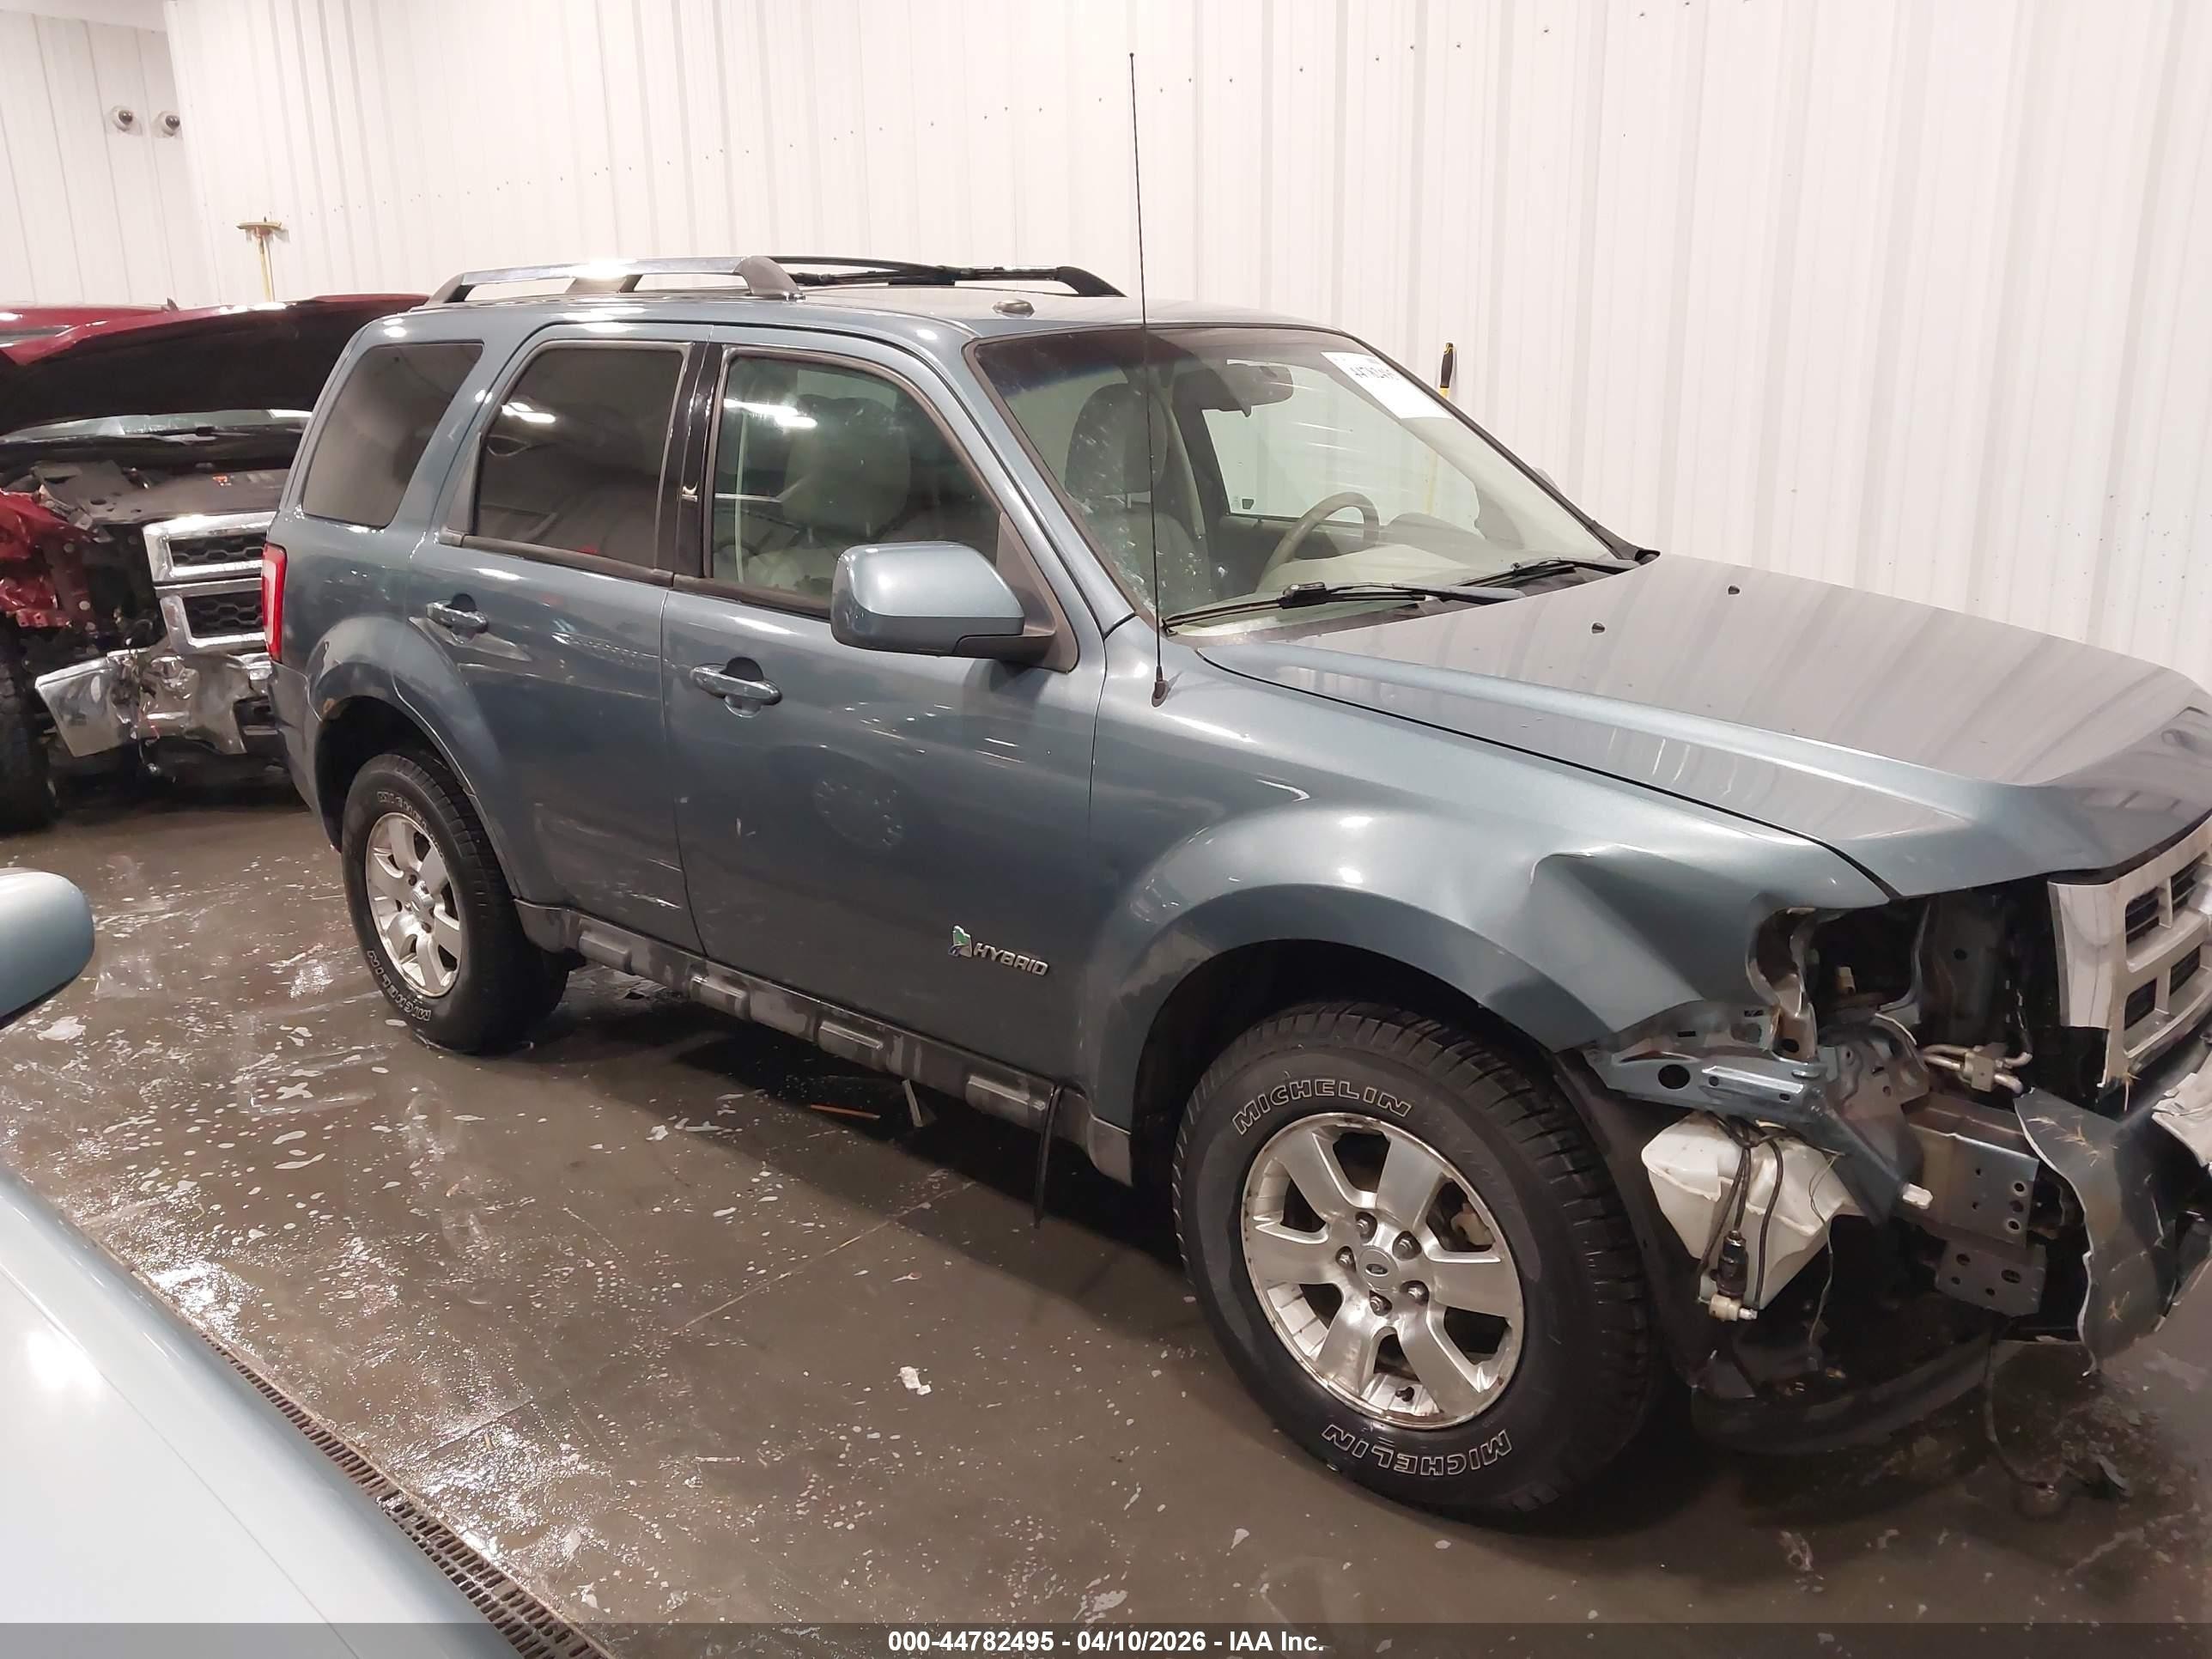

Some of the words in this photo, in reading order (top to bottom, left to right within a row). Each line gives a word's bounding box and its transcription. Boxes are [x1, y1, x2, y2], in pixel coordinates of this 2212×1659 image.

[974, 942, 1048, 975] HYBRID
[368, 950, 431, 1021] MICHELIN
[1232, 1079, 1412, 1135] MICHELIN
[1322, 1424, 1512, 1475] MICHELIN
